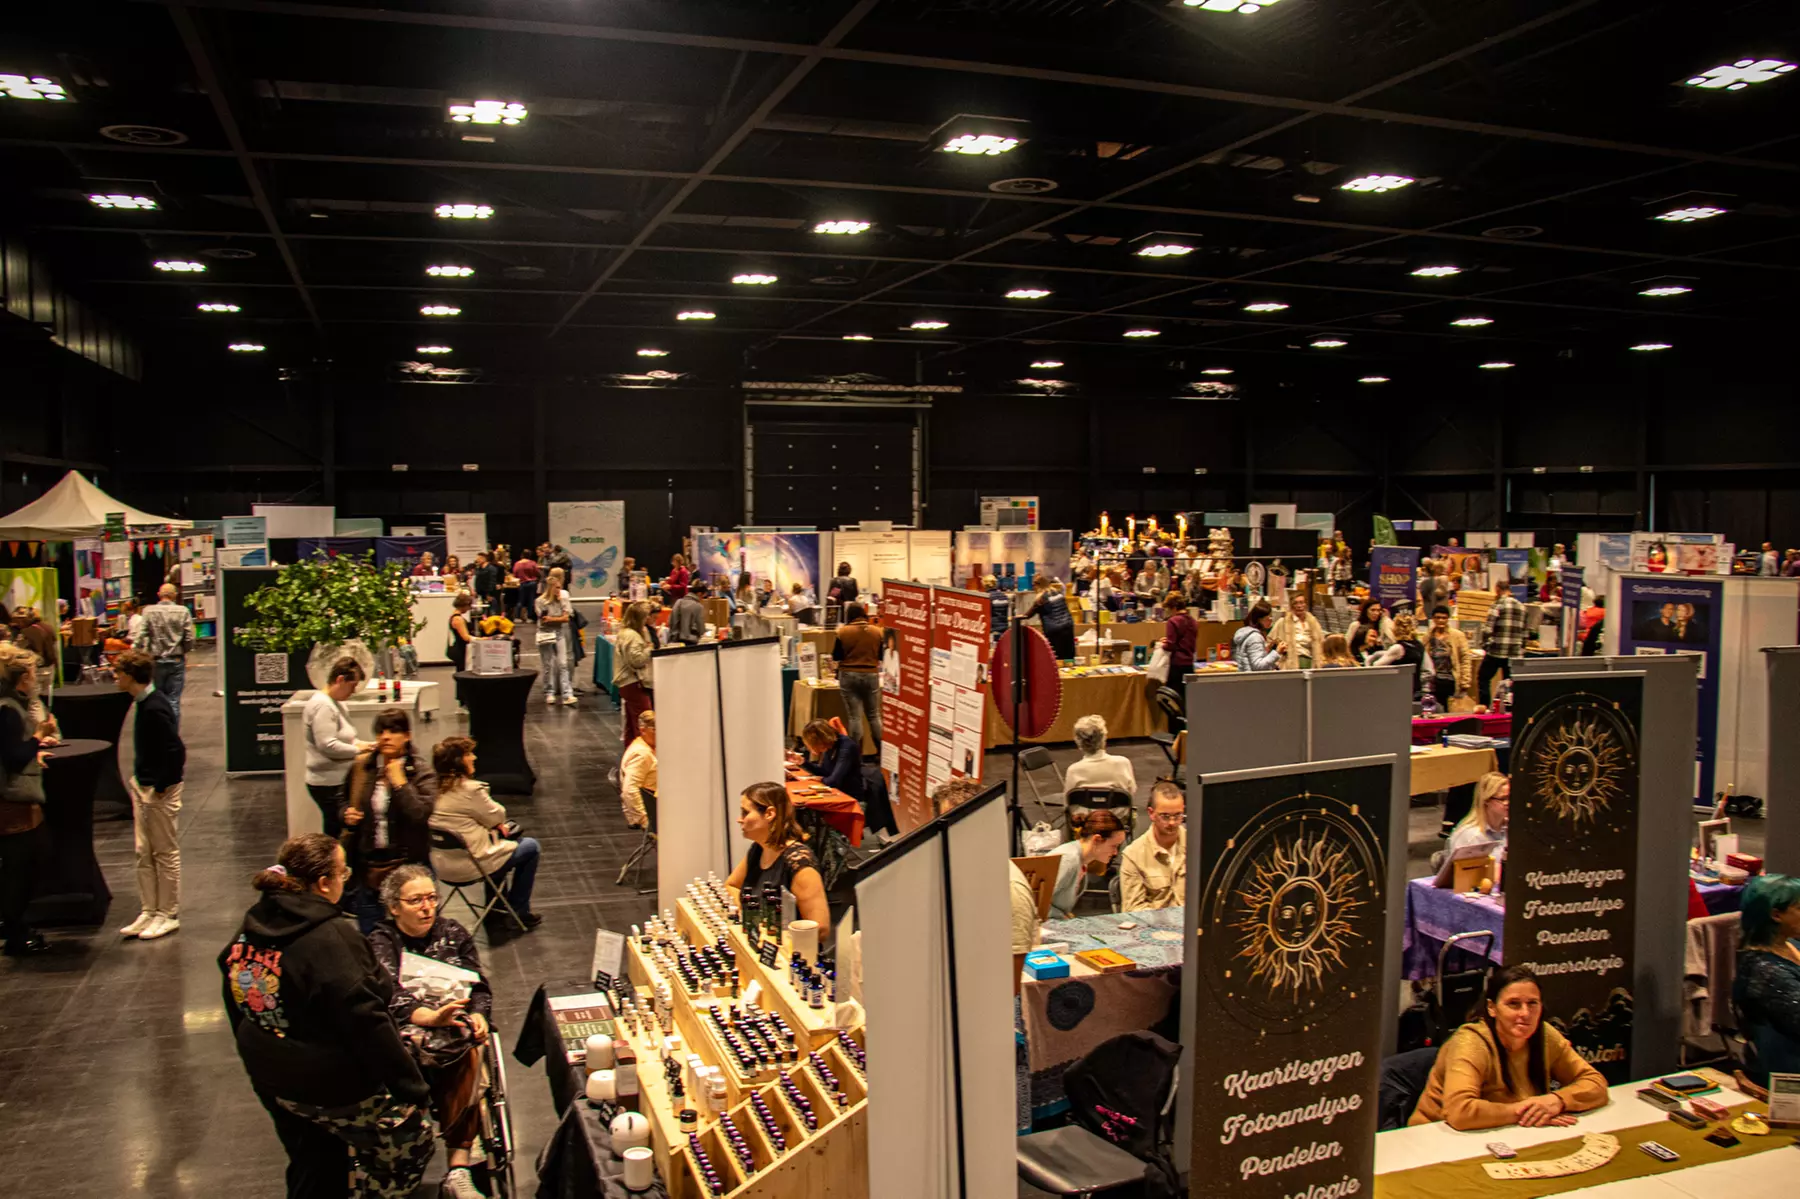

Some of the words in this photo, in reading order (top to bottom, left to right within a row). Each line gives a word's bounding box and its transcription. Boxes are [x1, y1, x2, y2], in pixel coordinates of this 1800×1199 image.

[1379, 573, 1410, 584] SHOP
[1525, 869, 1626, 890] Kaartleggen
[1522, 896, 1625, 919] Fotoanalyse
[1536, 927, 1611, 946] Pendelen
[1223, 1050, 1365, 1099] Kaartleggen
[1220, 1093, 1363, 1145] Fotoanalyse
[1239, 1140, 1344, 1181] Pendelen
